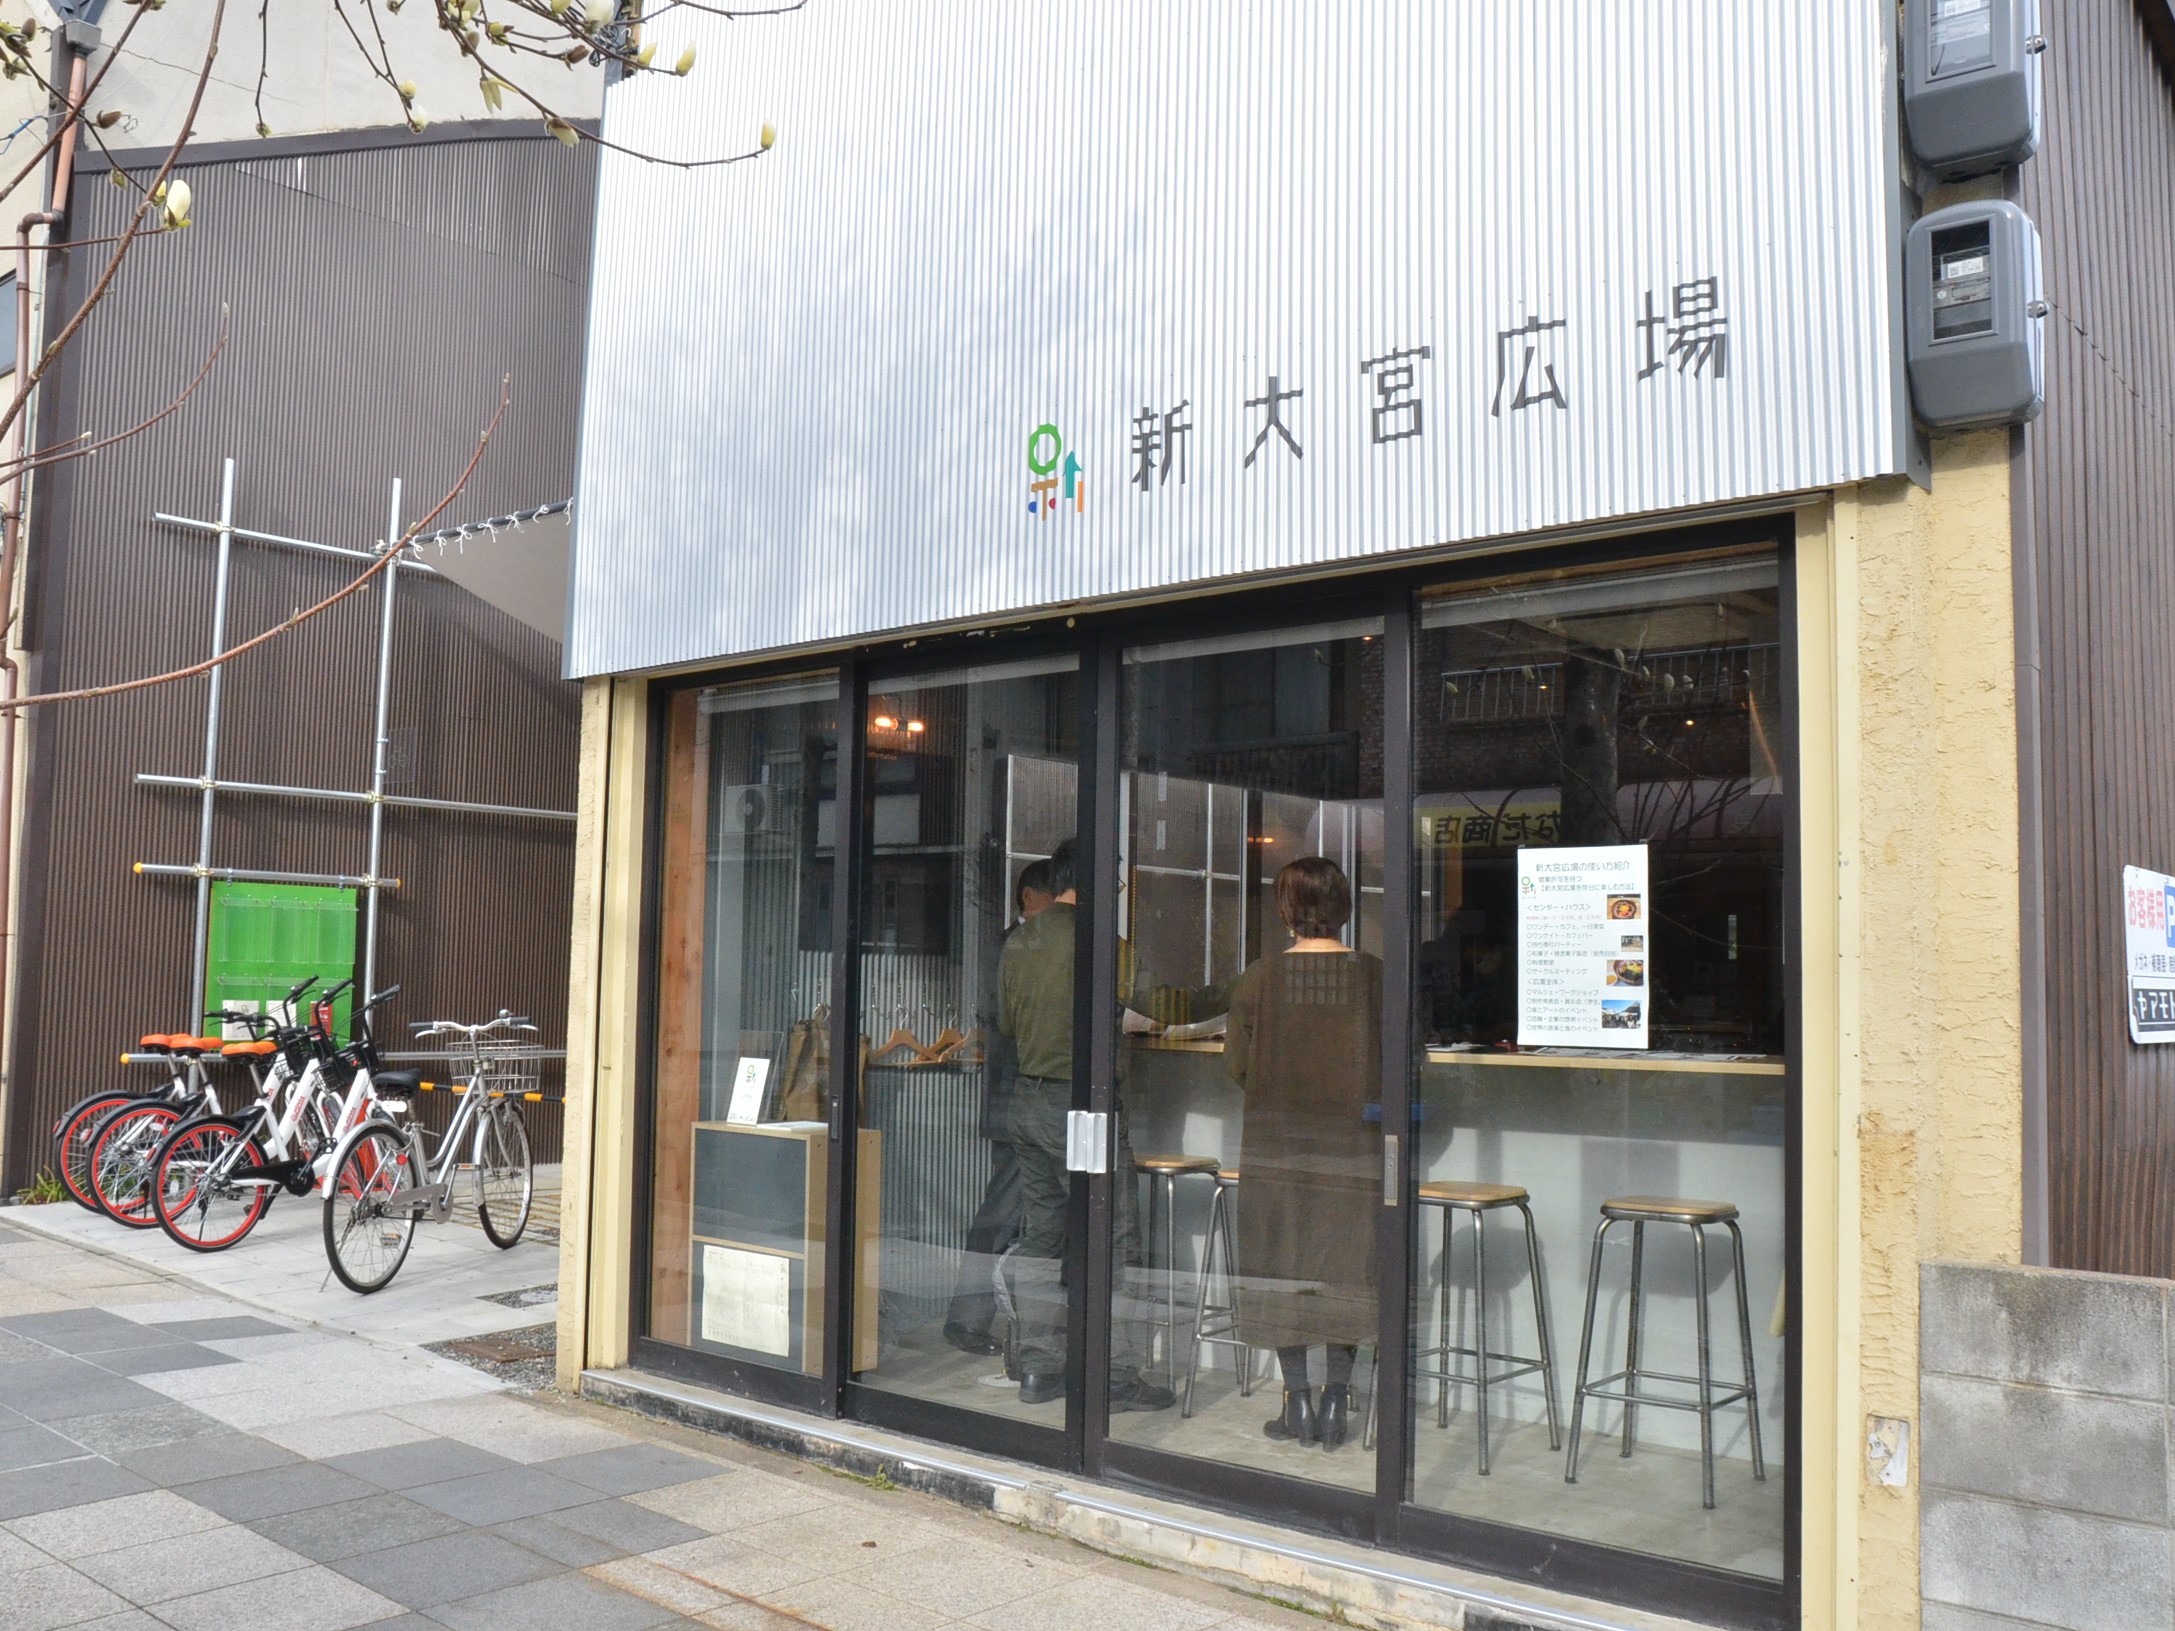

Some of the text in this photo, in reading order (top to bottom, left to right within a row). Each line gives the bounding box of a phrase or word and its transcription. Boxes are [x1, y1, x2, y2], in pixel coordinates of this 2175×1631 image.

[1131, 275, 1728, 491] 新大宮広場
[1535, 860, 1630, 873] 新大宮広場の使い方紹介
[2128, 885, 2165, 931] お客様用
[2168, 894, 2175, 938] P
